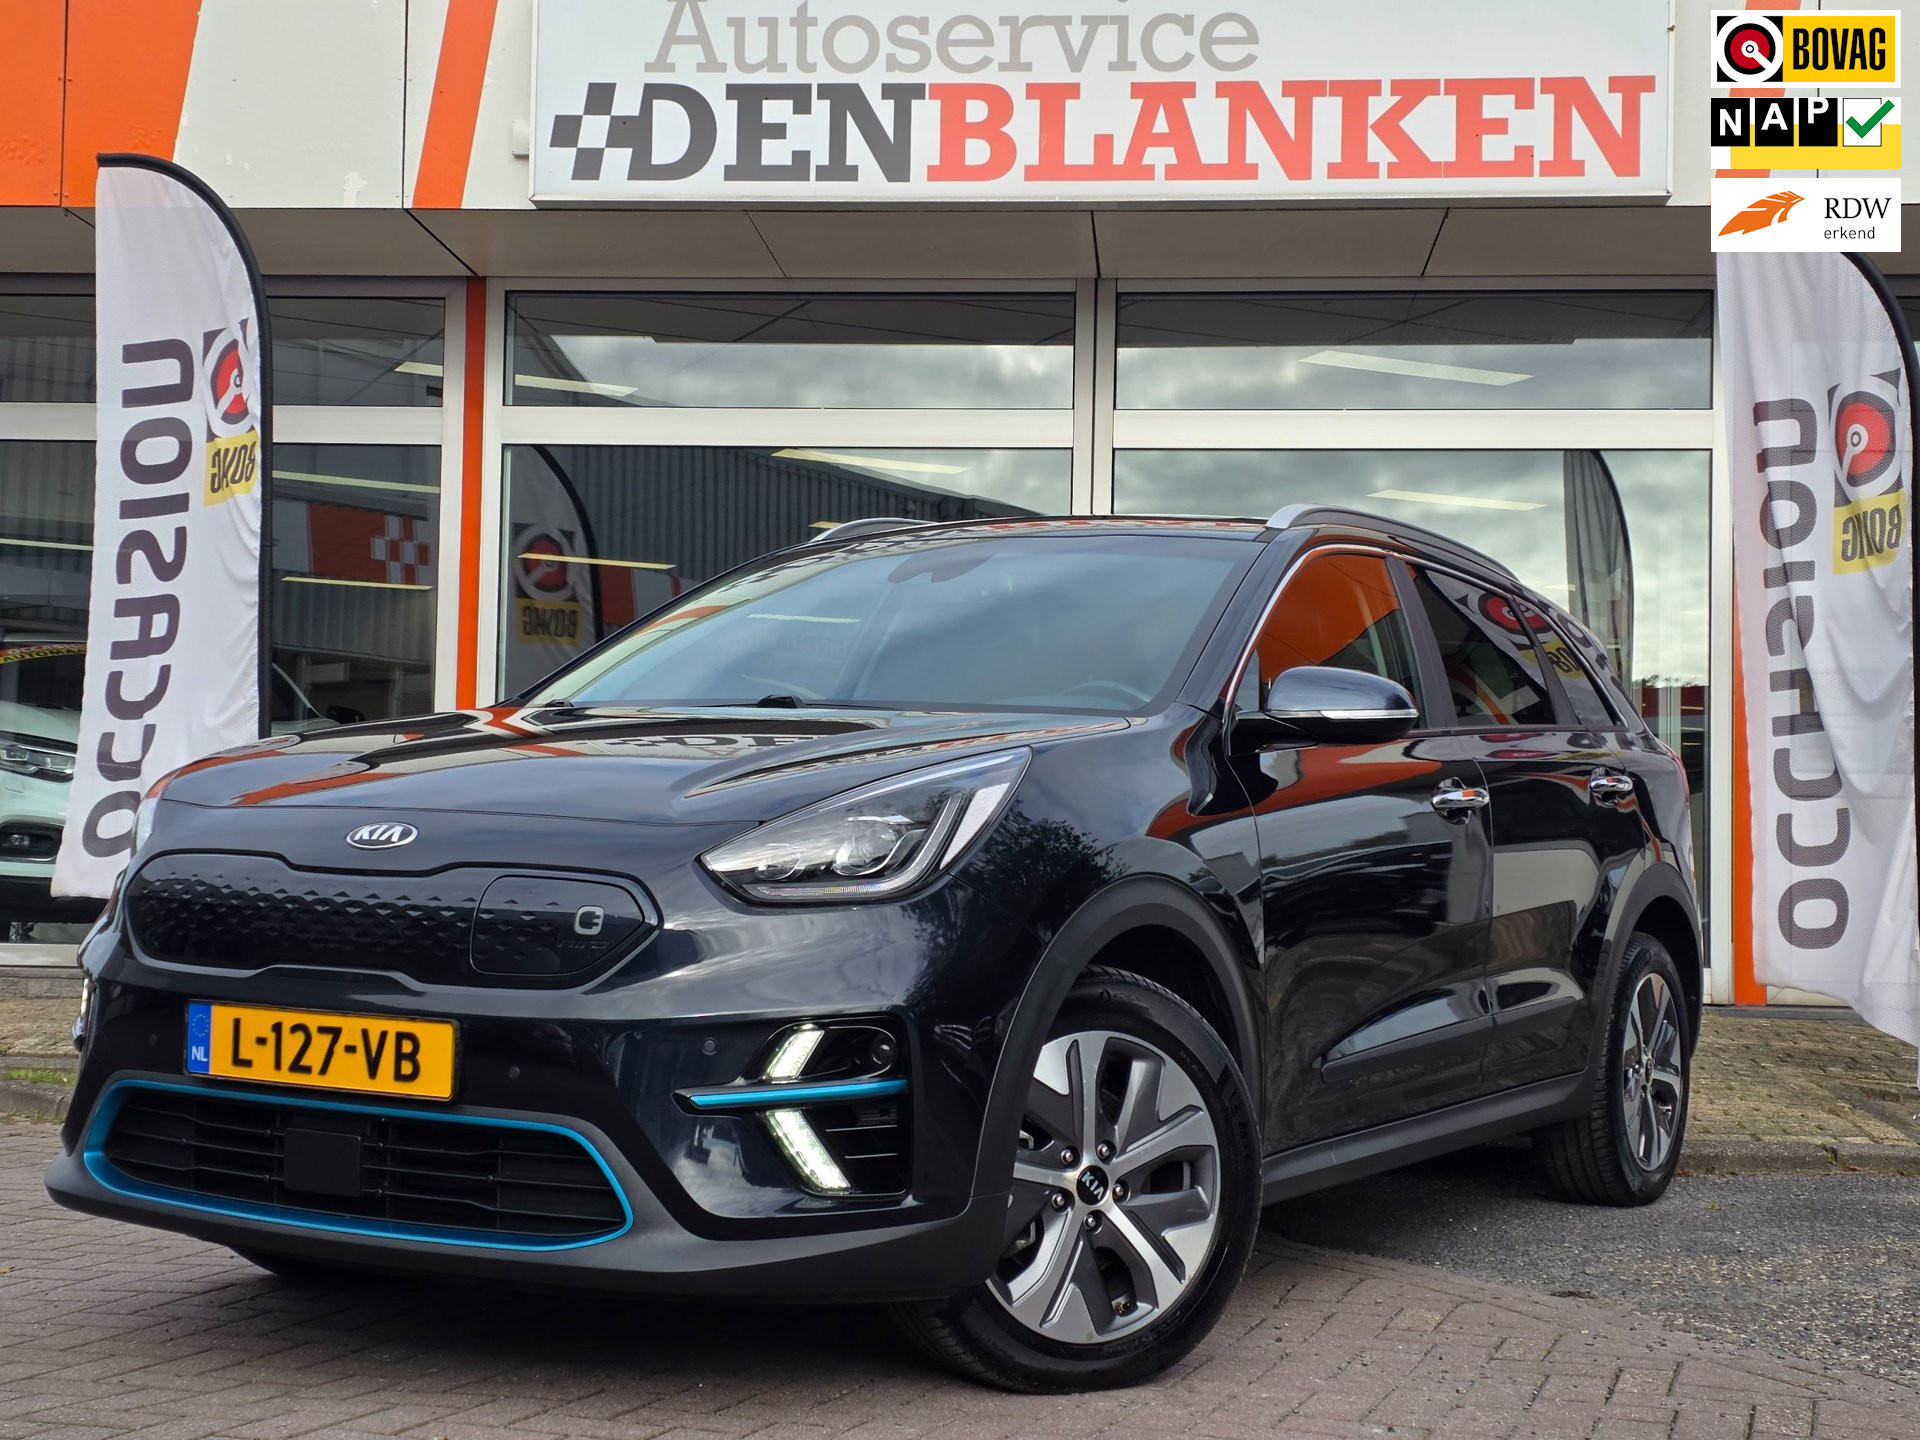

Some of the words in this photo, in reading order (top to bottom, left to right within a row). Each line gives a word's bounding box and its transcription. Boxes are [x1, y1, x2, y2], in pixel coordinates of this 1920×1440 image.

[645, 0, 1259, 75] Autoservice
[353, 824, 403, 842] KIA
[191, 1046, 208, 1062] NL
[231, 1017, 421, 1084] L-127-VB
[1081, 1170, 1104, 1200] KIA
